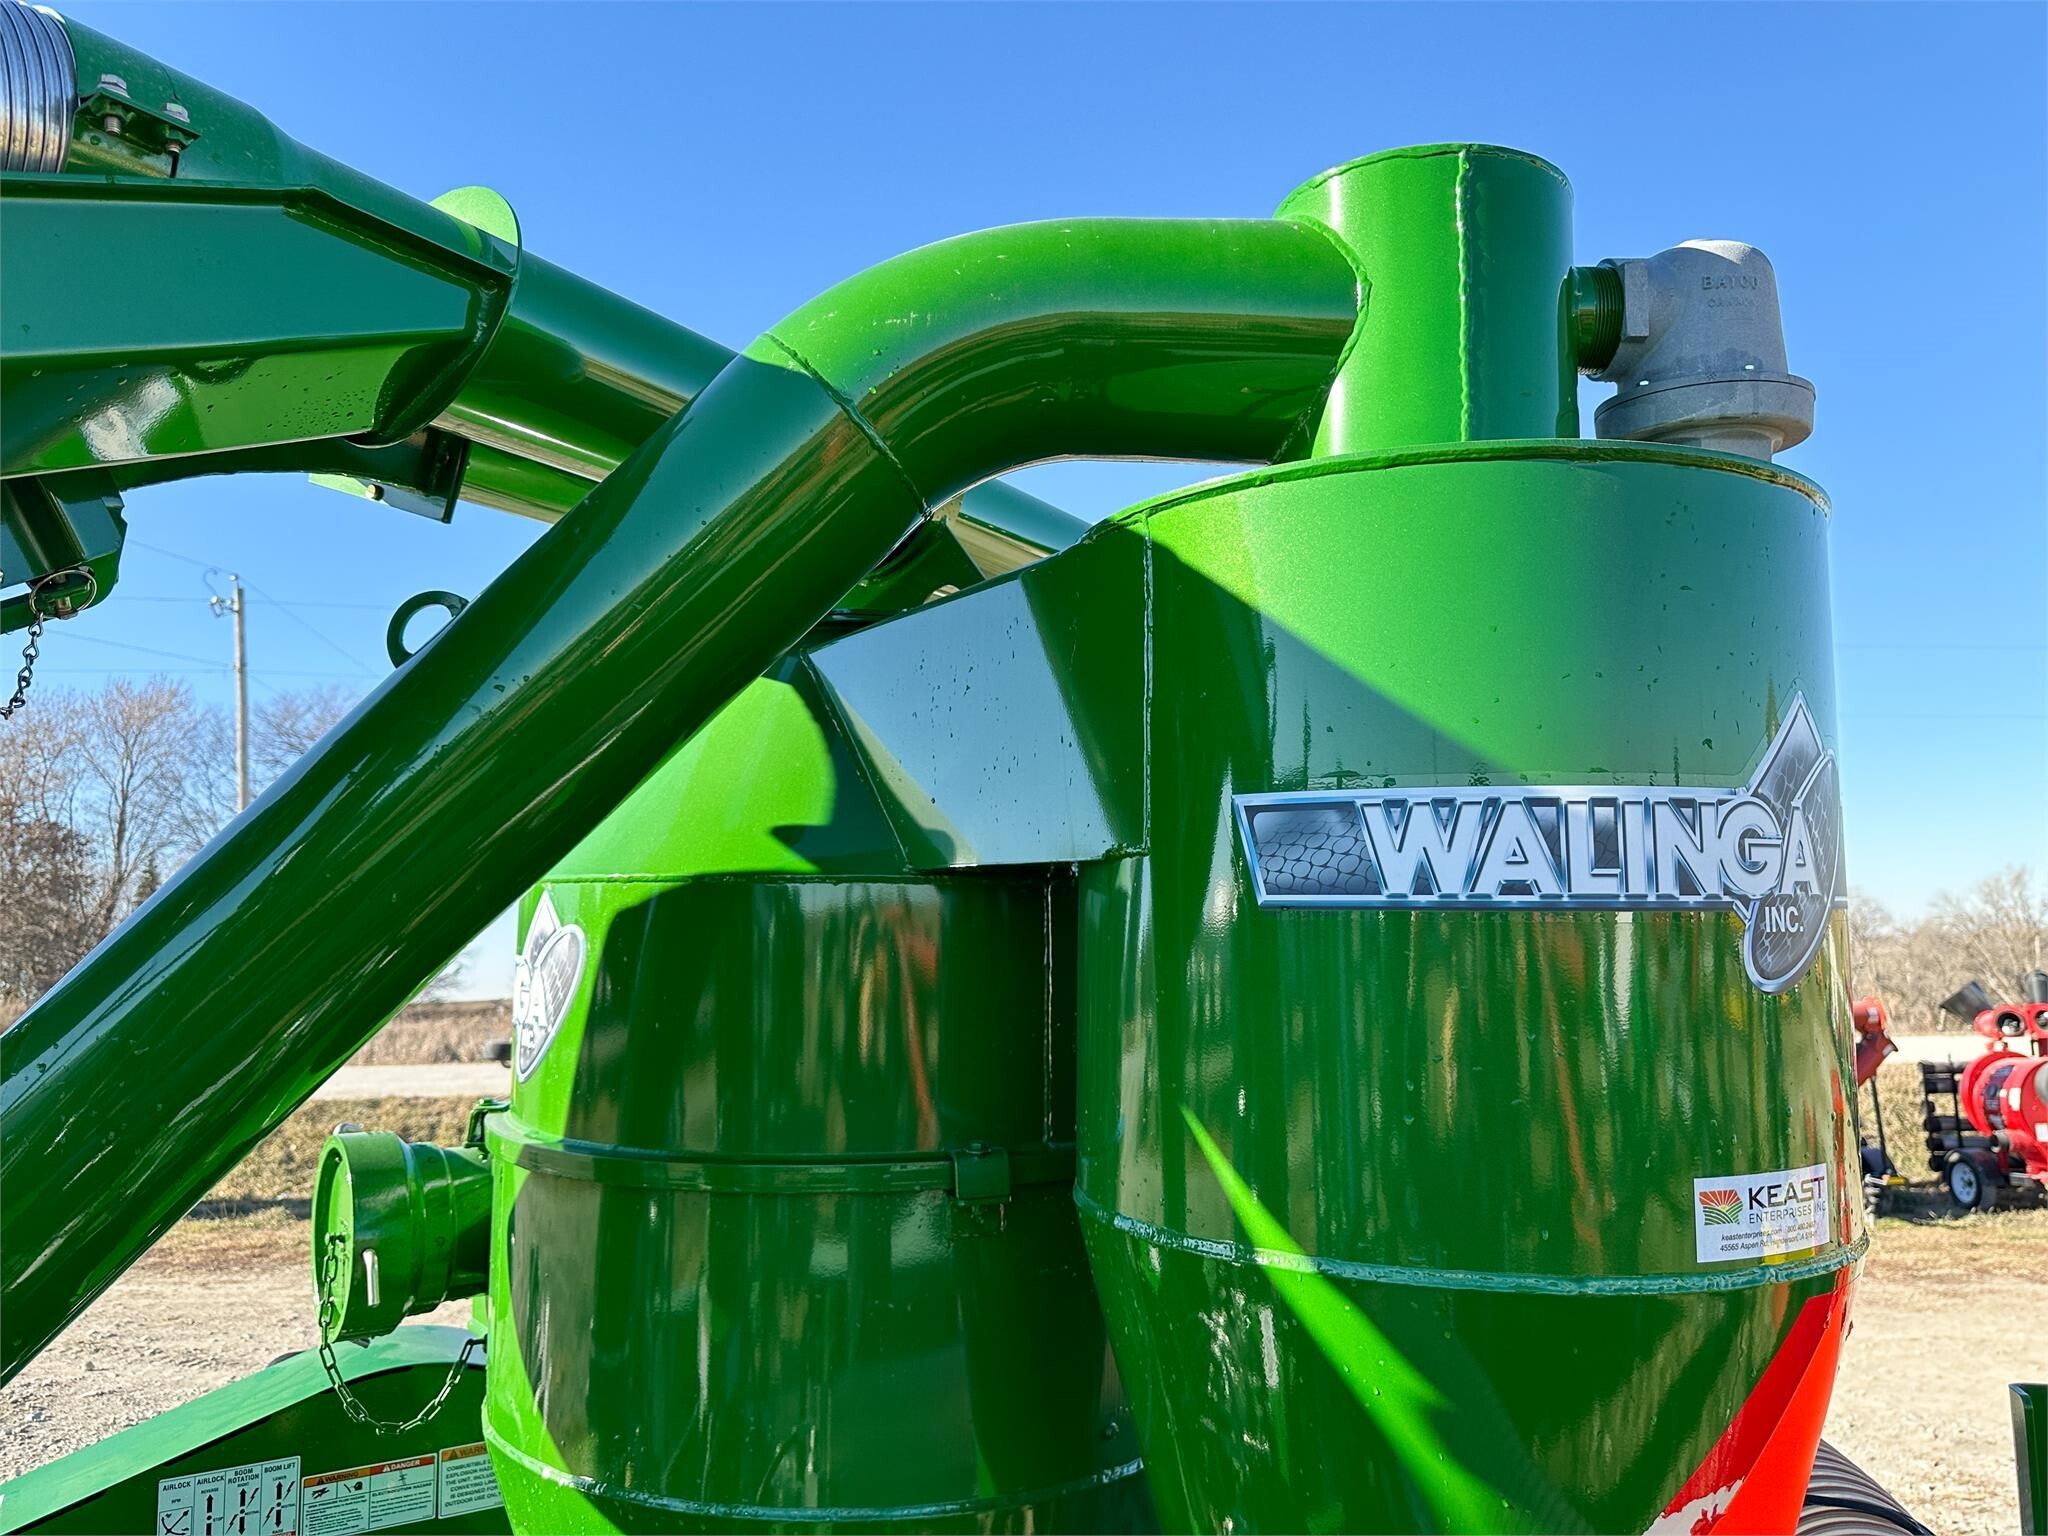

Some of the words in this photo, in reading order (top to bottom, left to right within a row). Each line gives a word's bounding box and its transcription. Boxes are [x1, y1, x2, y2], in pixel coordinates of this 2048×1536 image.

[1358, 795, 1825, 900] WALINGA
[1764, 905, 1804, 933] INC.
[1748, 1176, 1825, 1210] KEAST
[1749, 1204, 1812, 1224] ENTERPRISES
[1740, 1241, 1759, 1251] Aspen
[264, 1464, 282, 1473] BOOM
[283, 1462, 296, 1470] LIFT
[391, 1459, 421, 1470] DANGER
[234, 1467, 254, 1477] BOOM
[326, 1471, 359, 1482] WARNING
[446, 1469, 478, 1479] EXPLOSION
[197, 1475, 225, 1486] AIRLOCK
[228, 1473, 260, 1484] ROTATION
[163, 1480, 192, 1492] AIRLOCK
[450, 1481, 483, 1492] CONVEYING
[457, 1487, 485, 1498] DESIGNED
[445, 1496, 473, 1507] OUTDOOR
